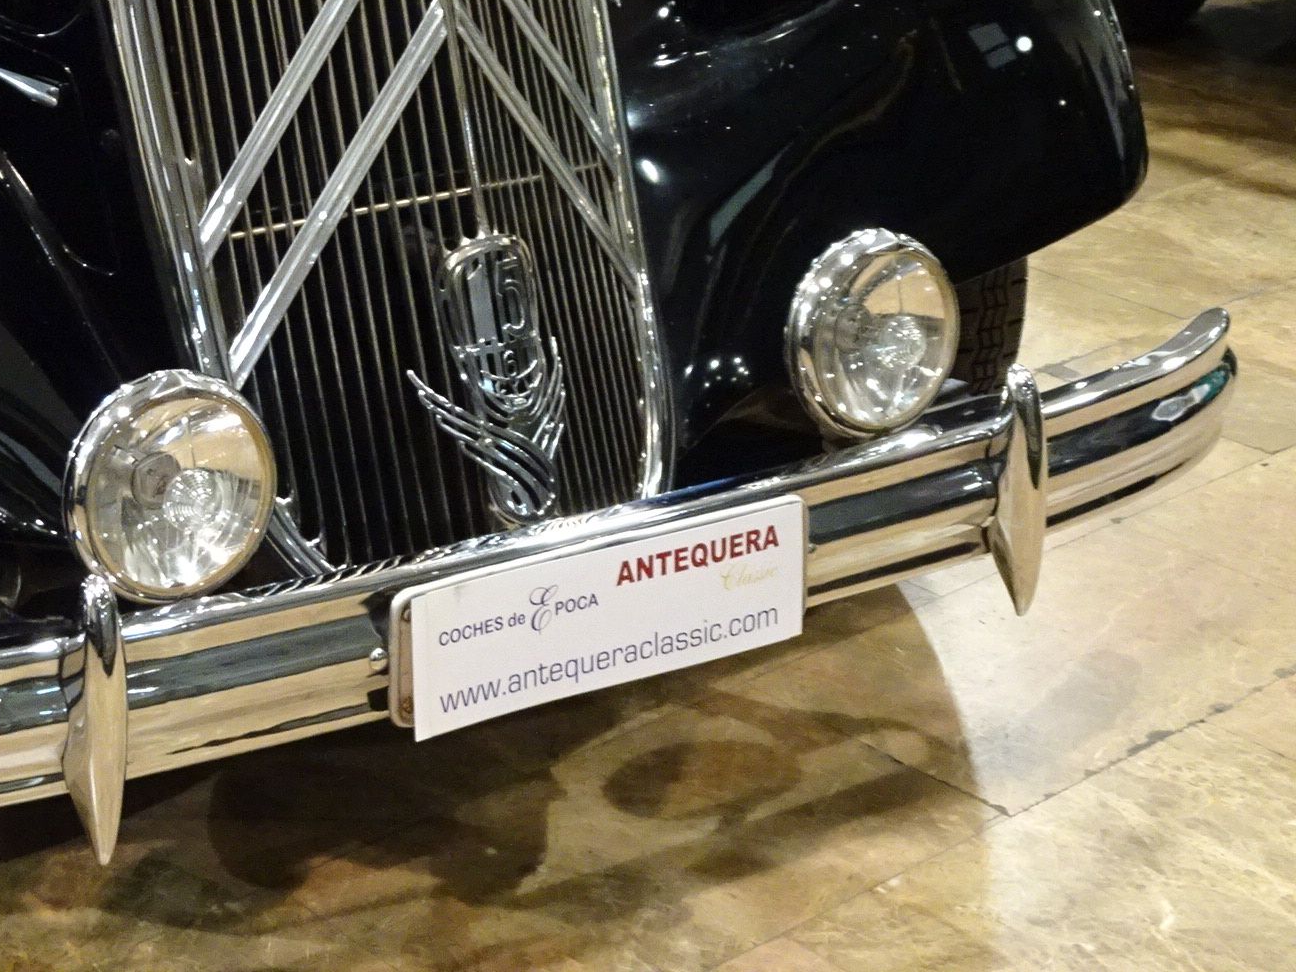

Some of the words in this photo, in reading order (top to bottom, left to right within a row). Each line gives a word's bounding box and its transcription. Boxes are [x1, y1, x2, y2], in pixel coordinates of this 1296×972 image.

[616, 525, 779, 586] ANTEQUERA
[438, 616, 504, 646] COCHES
[507, 612, 526, 628] de
[439, 606, 779, 714] www.antequeraclassic.com
